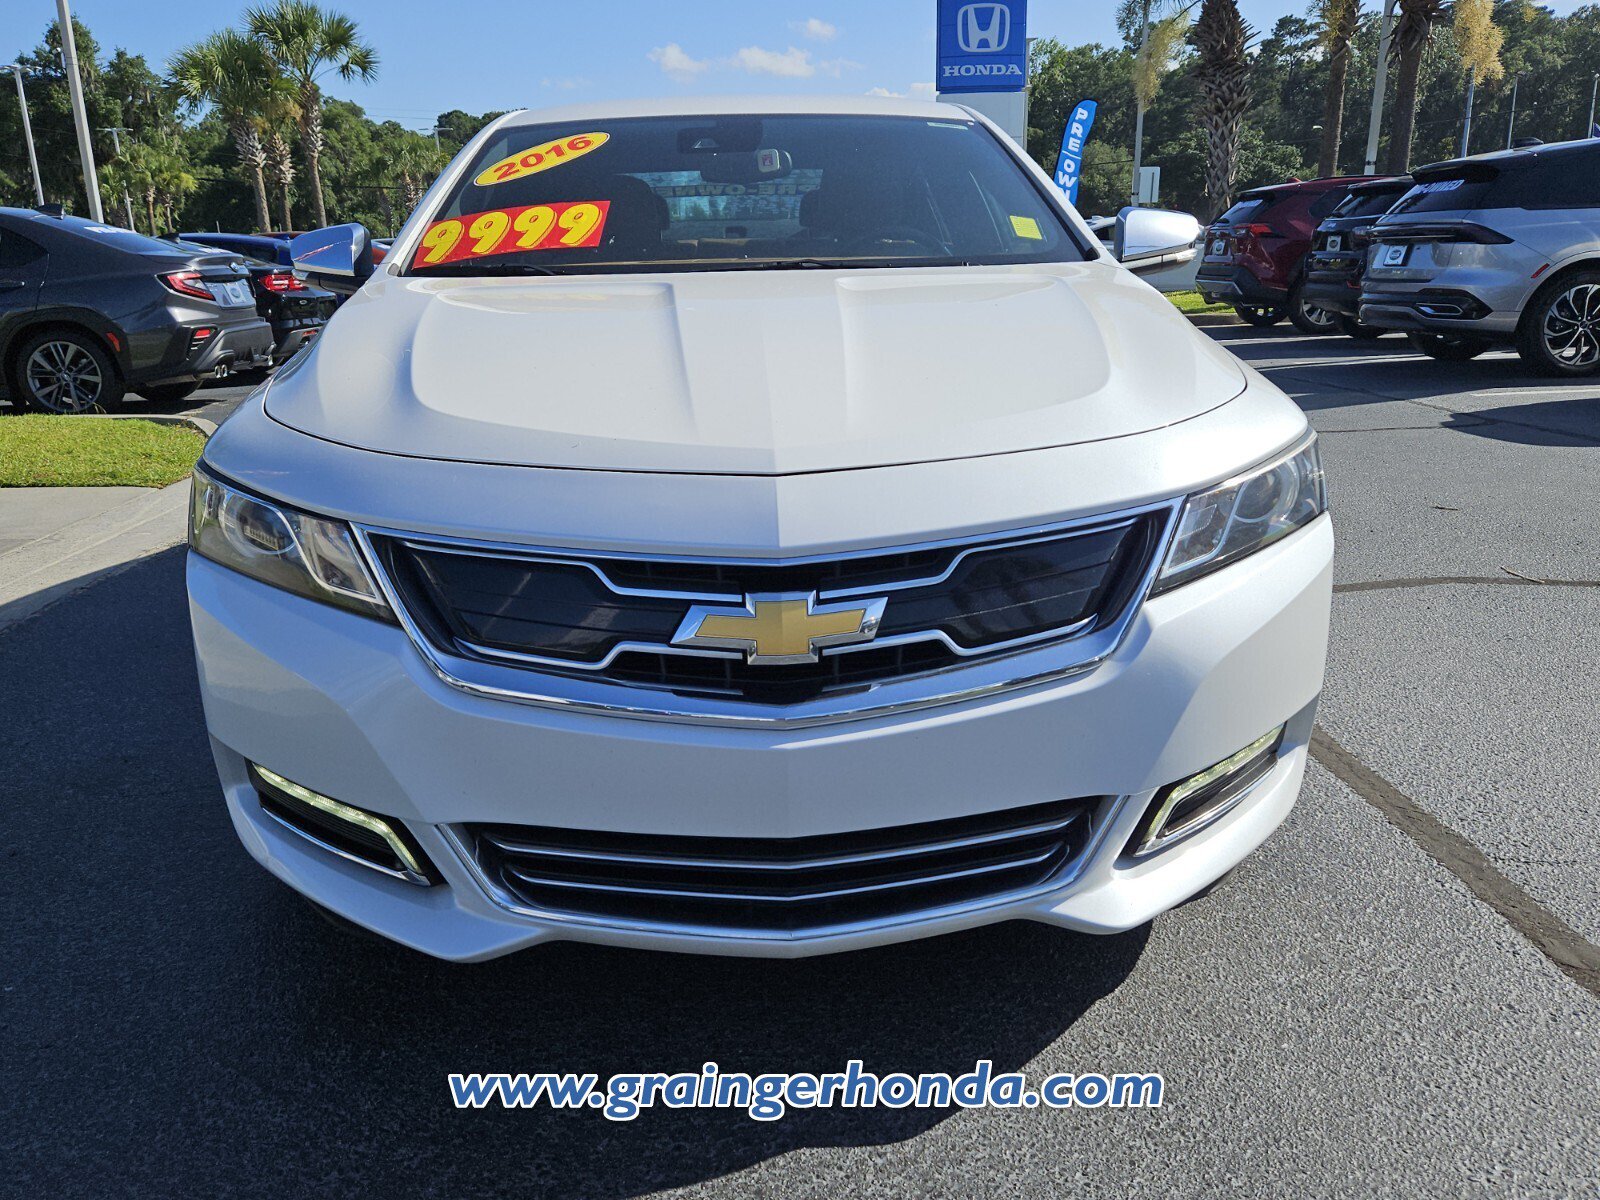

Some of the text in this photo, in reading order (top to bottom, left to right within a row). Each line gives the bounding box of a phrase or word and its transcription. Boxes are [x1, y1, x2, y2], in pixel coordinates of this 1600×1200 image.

[942, 64, 1022, 77] HONDA
[1068, 107, 1088, 152] PRE
[493, 136, 593, 181] 2016
[422, 203, 602, 263] 9999
